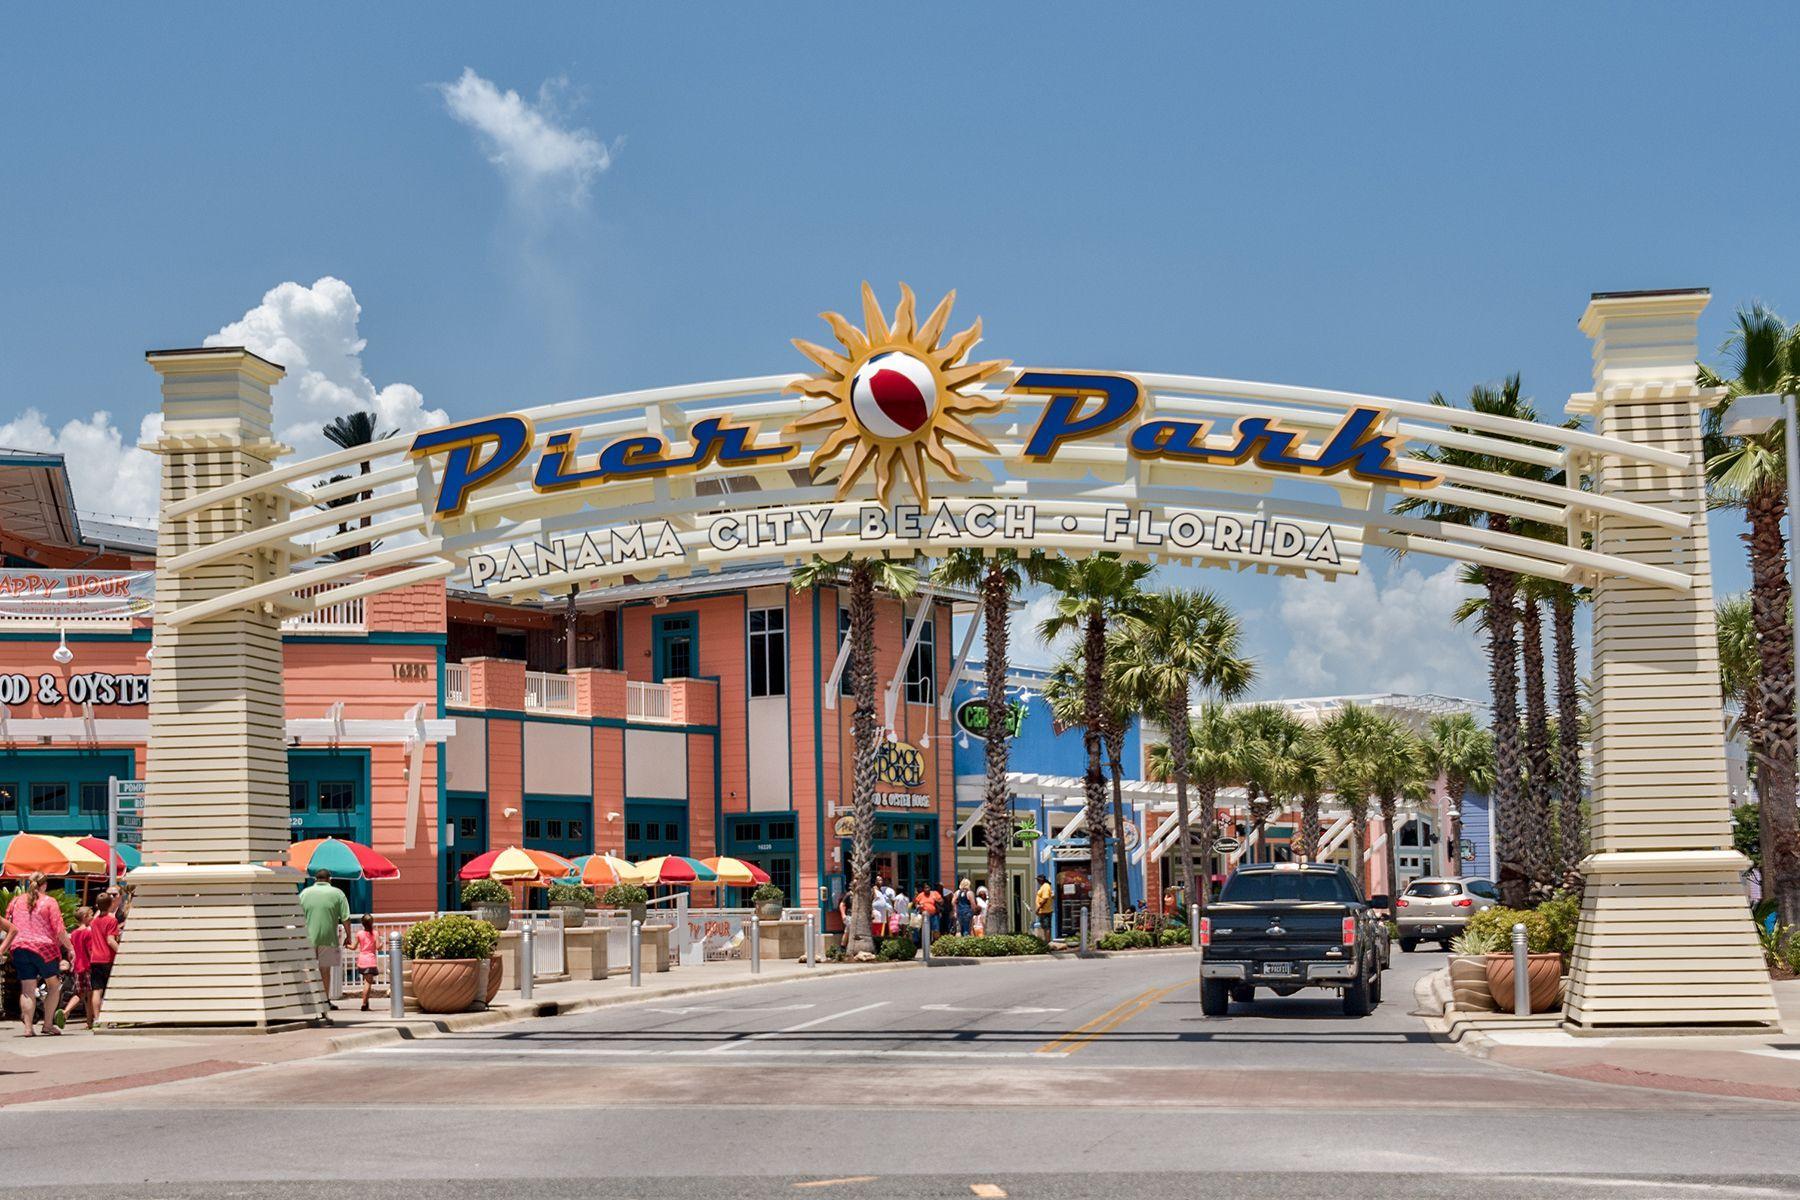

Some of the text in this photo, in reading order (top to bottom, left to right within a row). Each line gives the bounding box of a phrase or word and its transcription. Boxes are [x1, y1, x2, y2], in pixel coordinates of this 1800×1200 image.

[403, 368, 1447, 521] Pier Park
[468, 501, 1342, 588] PANAMA CITY BEACH FLORIDA
[66, 573, 131, 598] HOUR
[391, 663, 429, 682] 16220
[0, 672, 148, 706] OD & OYSTE
[888, 741, 920, 766] BACK
[877, 755, 926, 787] PORCH
[704, 921, 730, 938] HOUR
